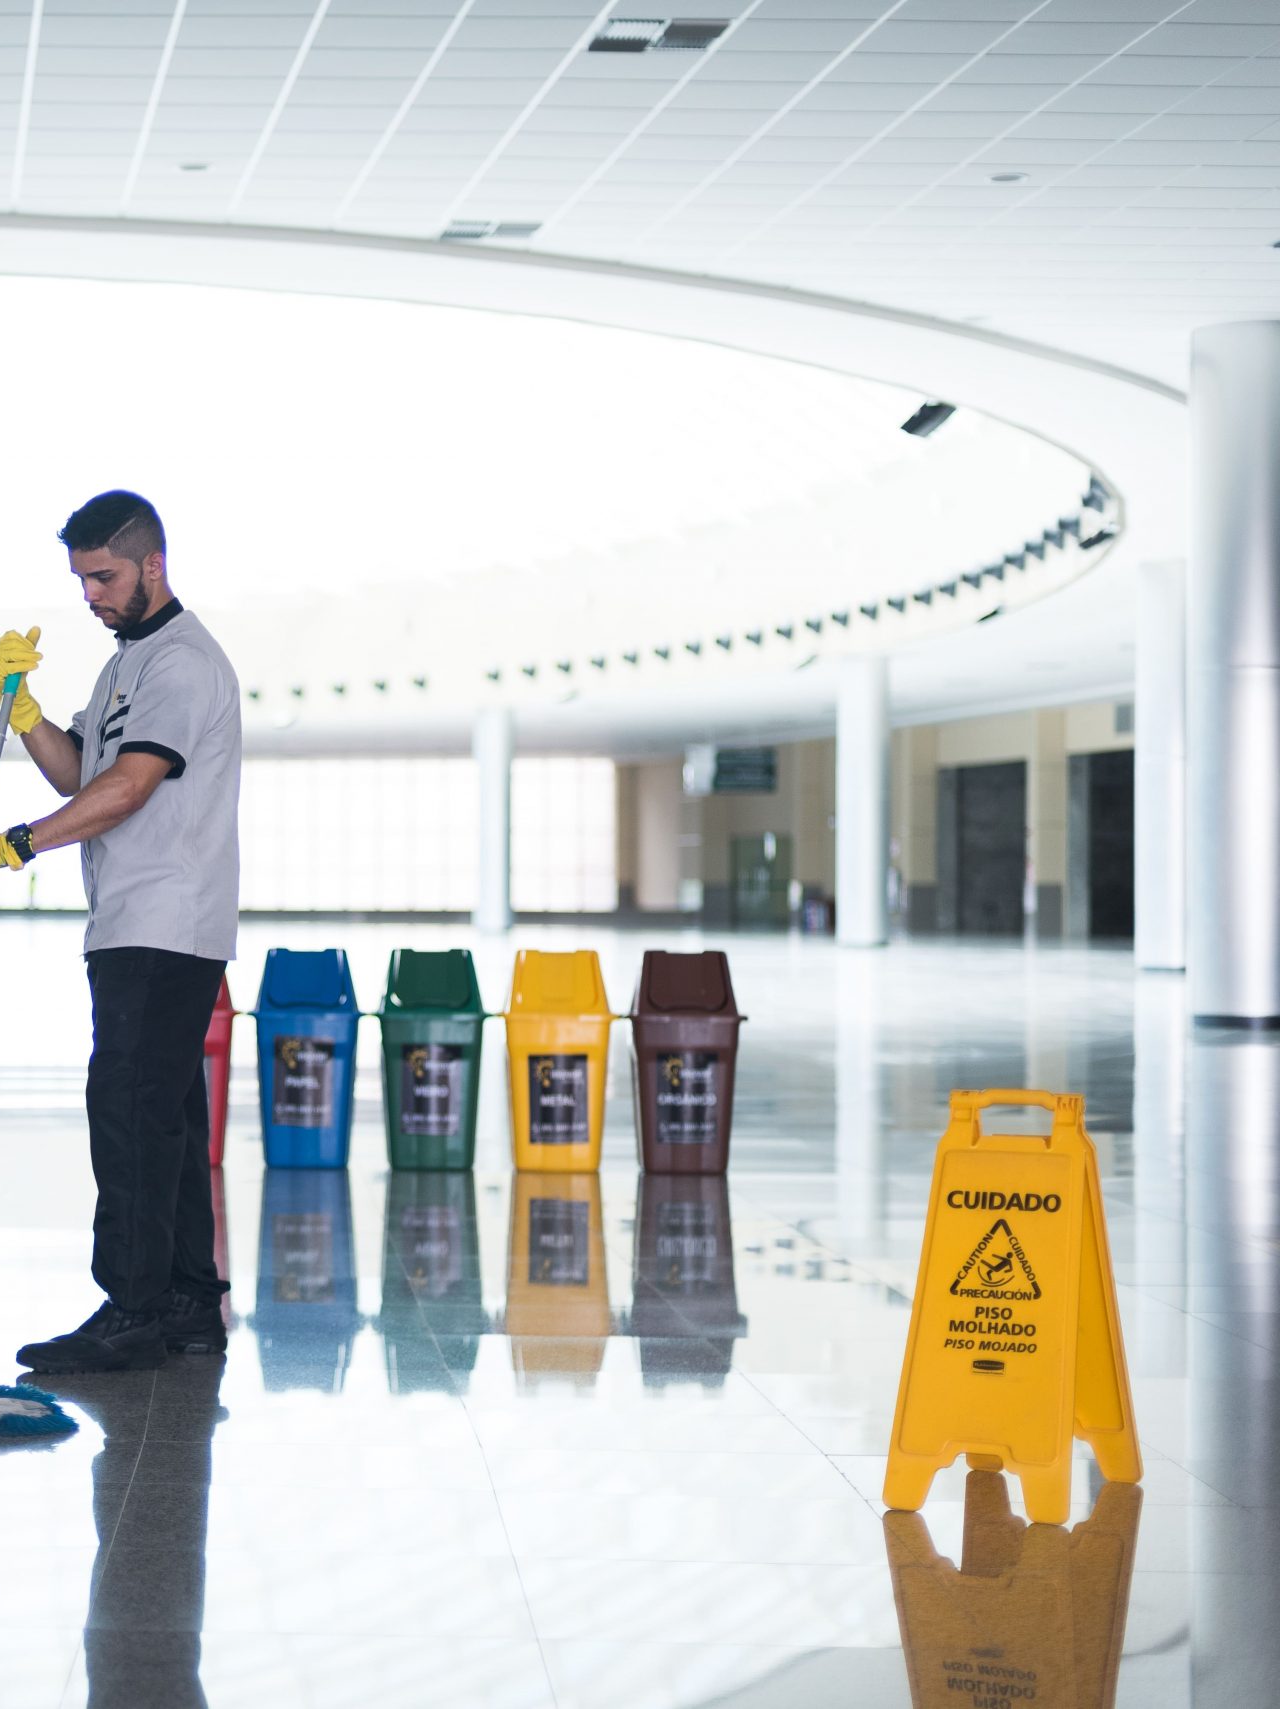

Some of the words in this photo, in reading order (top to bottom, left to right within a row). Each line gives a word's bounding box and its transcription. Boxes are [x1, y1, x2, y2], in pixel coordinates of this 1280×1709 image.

[541, 1095, 576, 1106] METAL
[947, 1190, 1062, 1213] CUIDADO
[957, 1233, 993, 1280] CAUTION
[1008, 1236, 1036, 1281] CUIDADO
[959, 1288, 1032, 1301] PRECAUCIÓN
[974, 1306, 1013, 1320] PISO
[949, 1320, 1036, 1337] MOLHADO
[944, 1338, 975, 1349] PISO
[978, 1341, 1038, 1354] MOJADO
